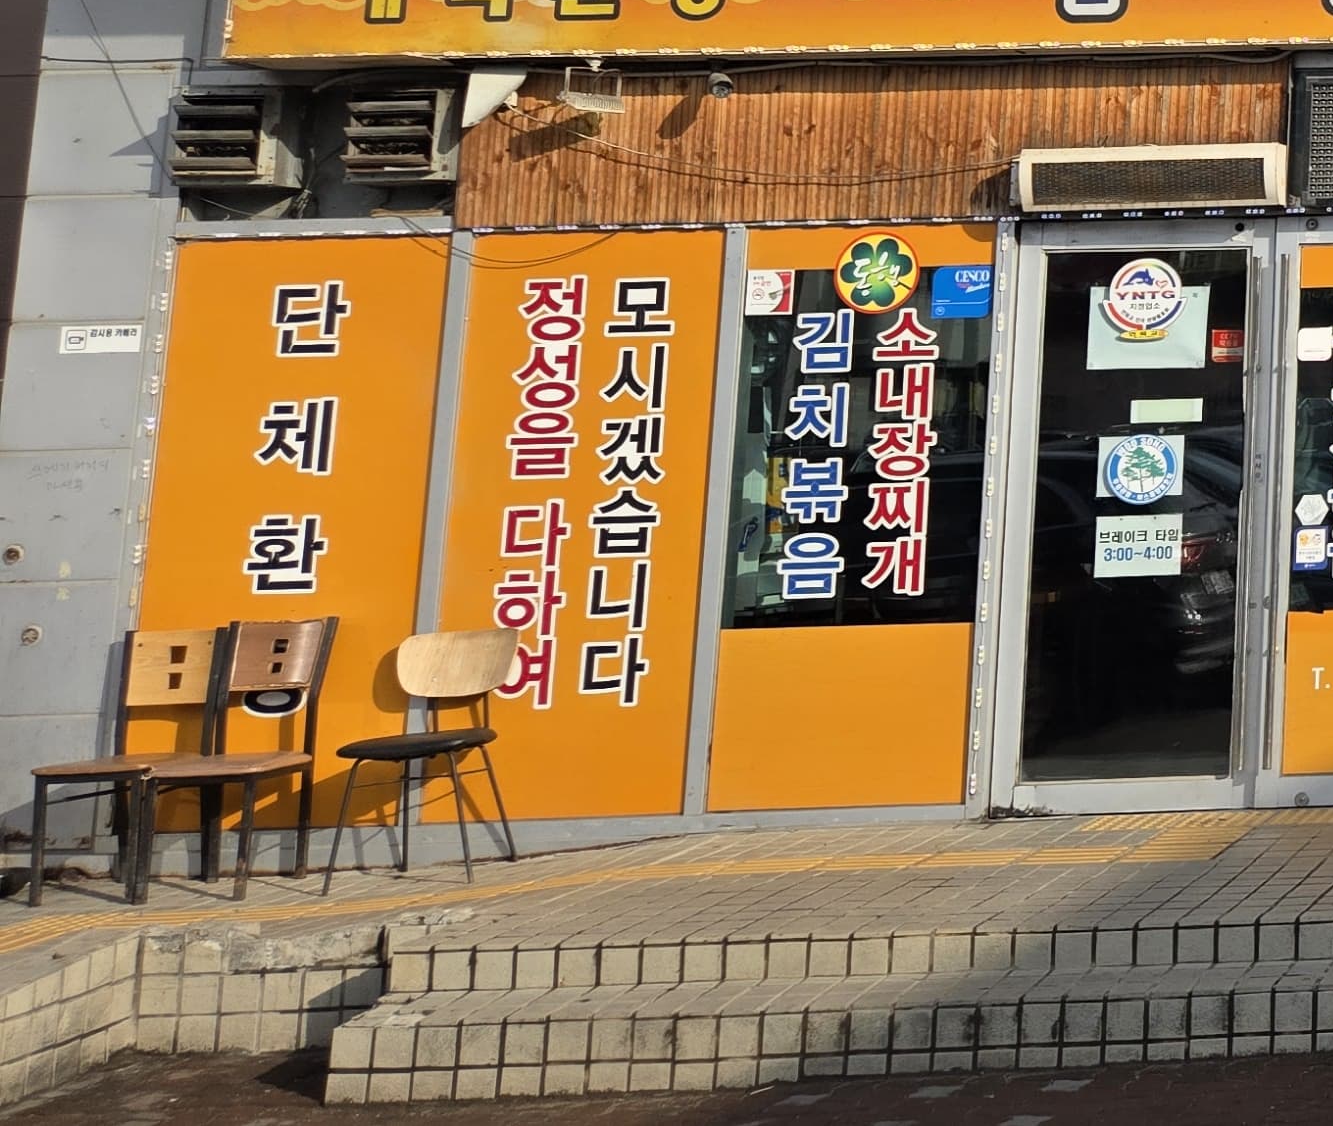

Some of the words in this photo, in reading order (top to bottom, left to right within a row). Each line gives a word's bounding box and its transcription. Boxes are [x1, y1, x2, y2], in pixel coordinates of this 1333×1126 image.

[506, 275, 588, 480] 정성을
[1116, 290, 1176, 301] YNTG
[578, 275, 676, 708] 모시겠습니다
[777, 308, 855, 600] 김치볶음
[861, 307, 939, 597] 소내장찌개
[1098, 530, 1148, 544] 브레이크
[1155, 528, 1179, 542] 타임
[1312, 667, 1331, 690] T.
